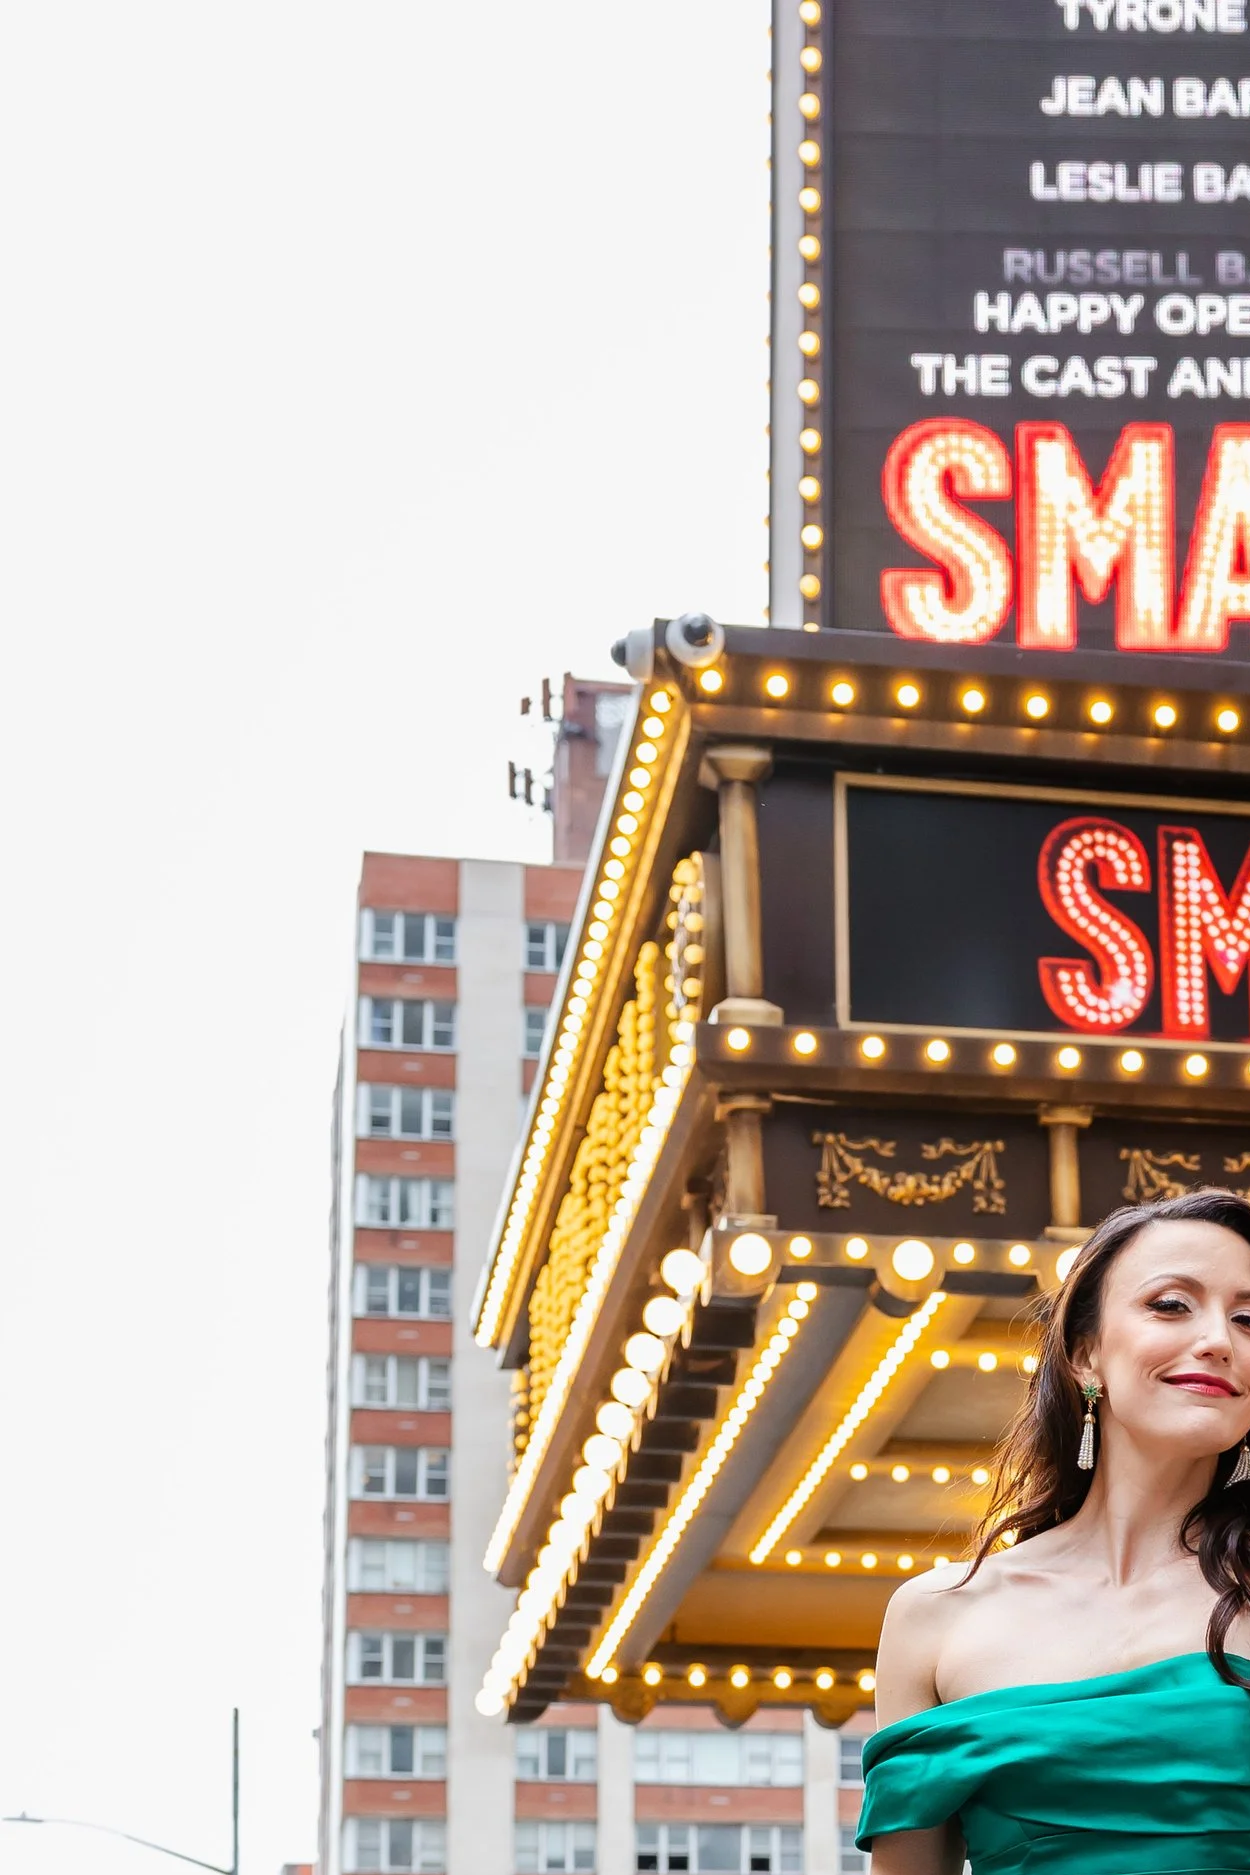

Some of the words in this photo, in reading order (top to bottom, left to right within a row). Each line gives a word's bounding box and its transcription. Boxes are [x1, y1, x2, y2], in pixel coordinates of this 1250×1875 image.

[1056, 0, 1247, 33] TYRONE
[1040, 76, 1164, 117] JEAN
[1030, 161, 1184, 202] LESLIE
[1001, 247, 1203, 287] RUSSELL
[974, 291, 1144, 334] HAPPY
[911, 353, 1011, 396] THE
[1021, 355, 1157, 398] CAST
